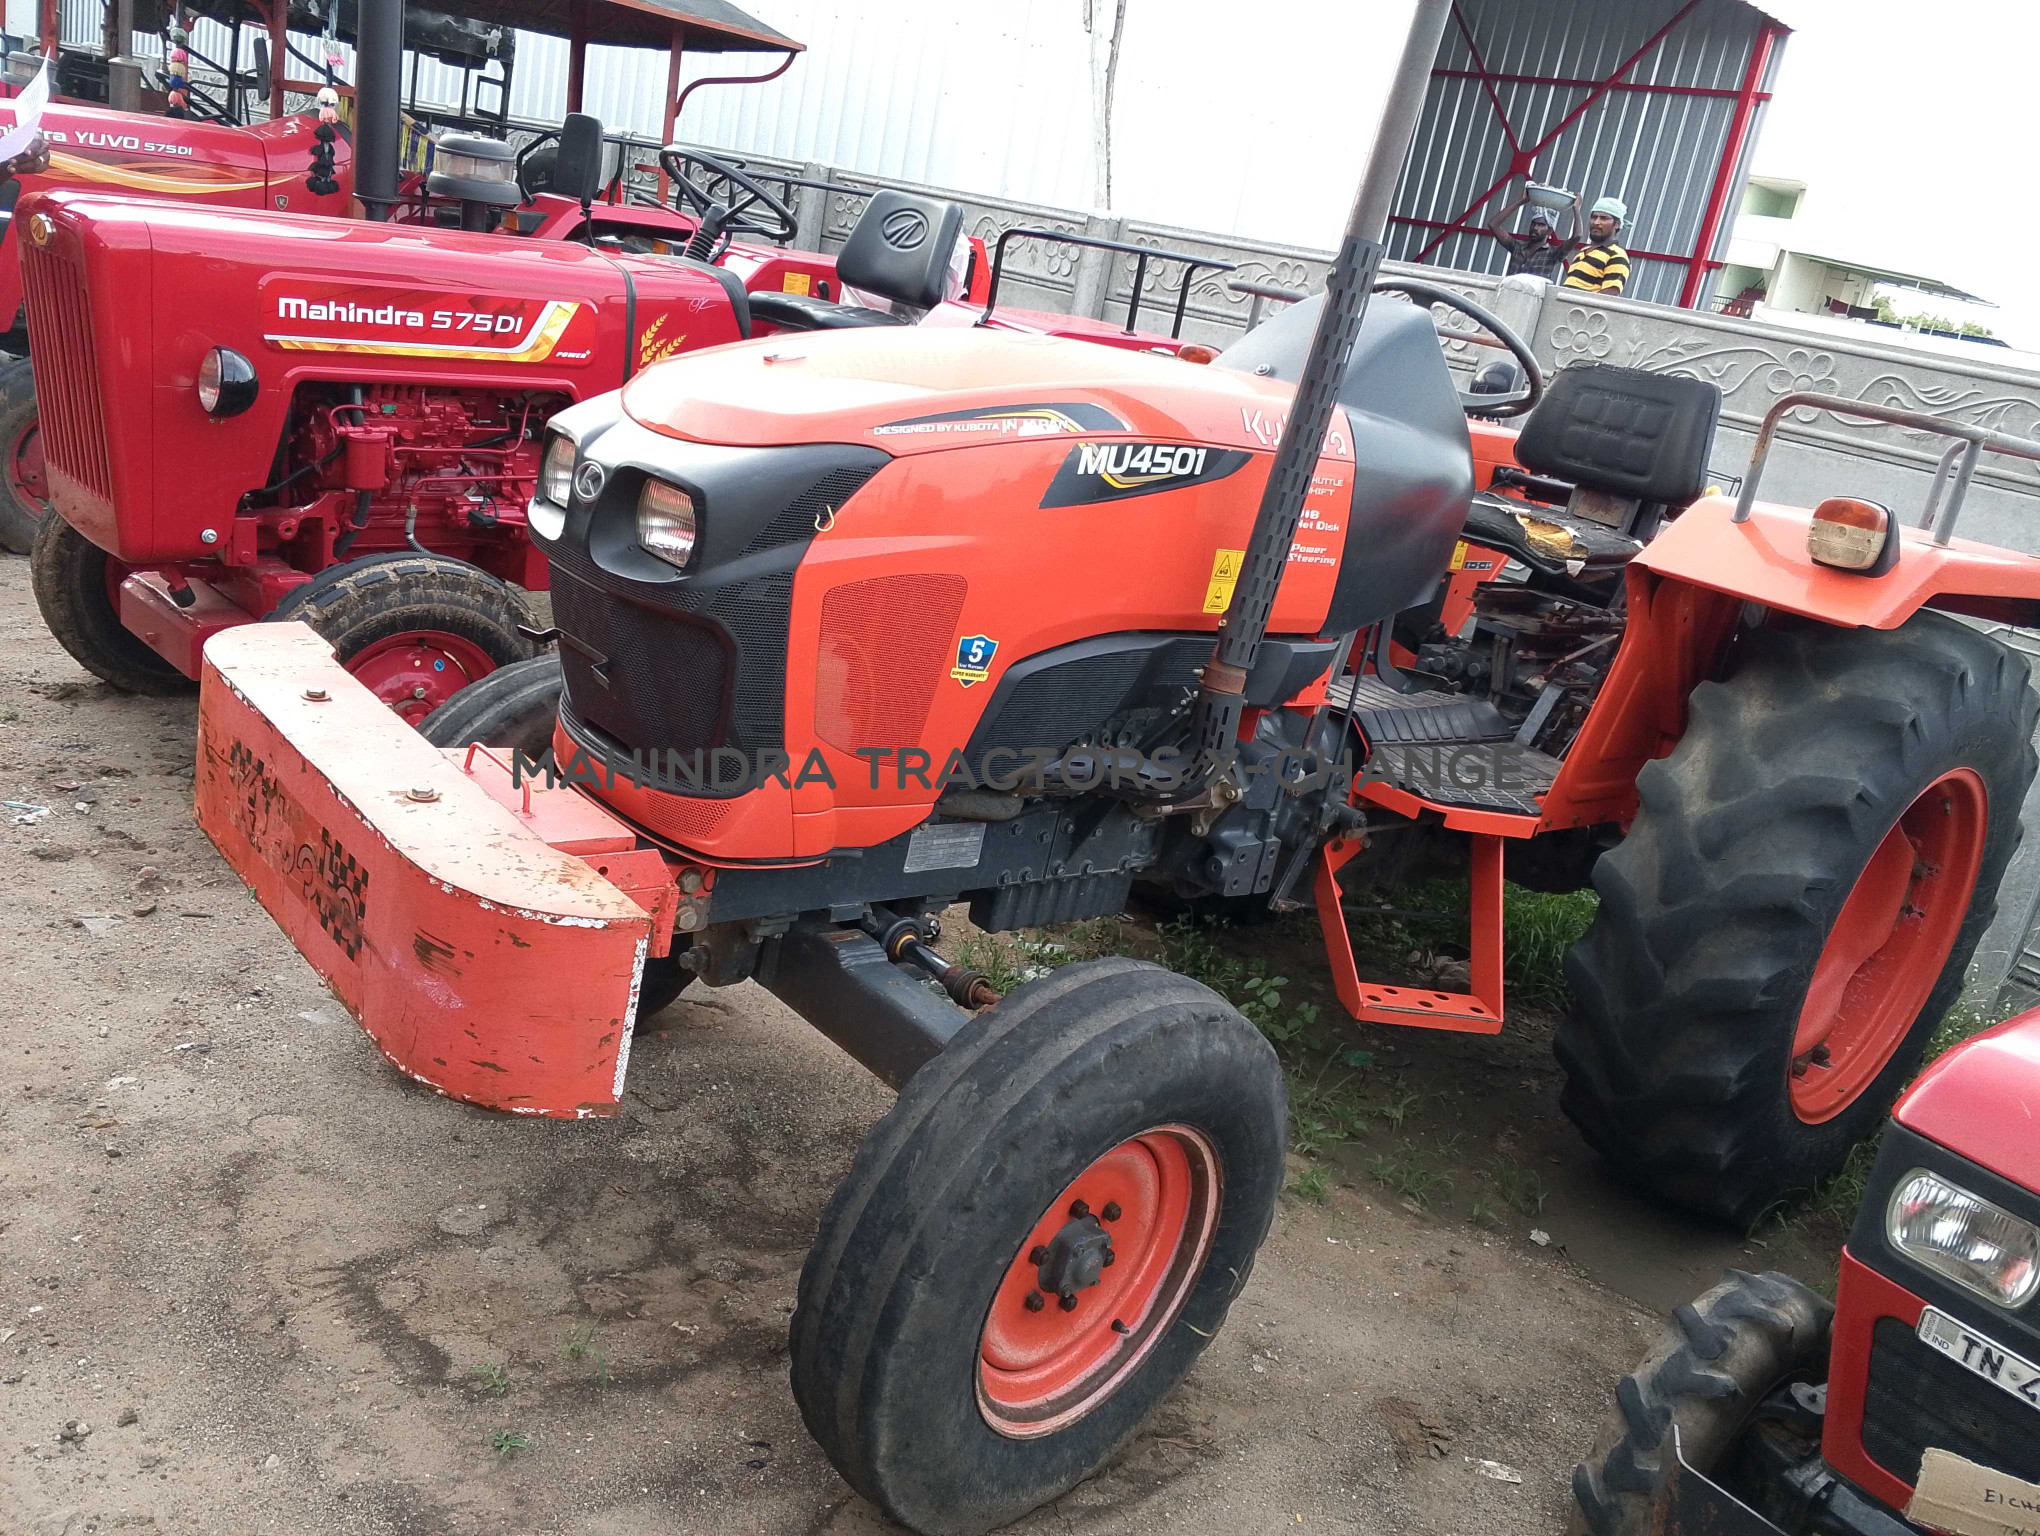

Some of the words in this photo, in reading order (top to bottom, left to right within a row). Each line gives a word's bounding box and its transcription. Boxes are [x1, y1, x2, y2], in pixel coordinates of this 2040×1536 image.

[75, 130, 139, 150] YUVO
[144, 142, 192, 156] 575DI
[278, 297, 424, 327] Mahindra
[431, 310, 523, 334] 575DI
[873, 425, 935, 436] DESIGNED
[936, 424, 951, 432] BY
[954, 422, 1000, 432] KUBOTA
[1002, 418, 1017, 434] IN
[1077, 445, 1208, 476] MU4501
[1311, 476, 1344, 487] HUTTLE
[1315, 520, 1340, 532] Disk
[1290, 543, 1327, 554] Power
[1287, 552, 1337, 566] Steering
[968, 640, 985, 663] 5
[1931, 1335, 1950, 1350] IND
[1961, 1334, 2004, 1379] TN
